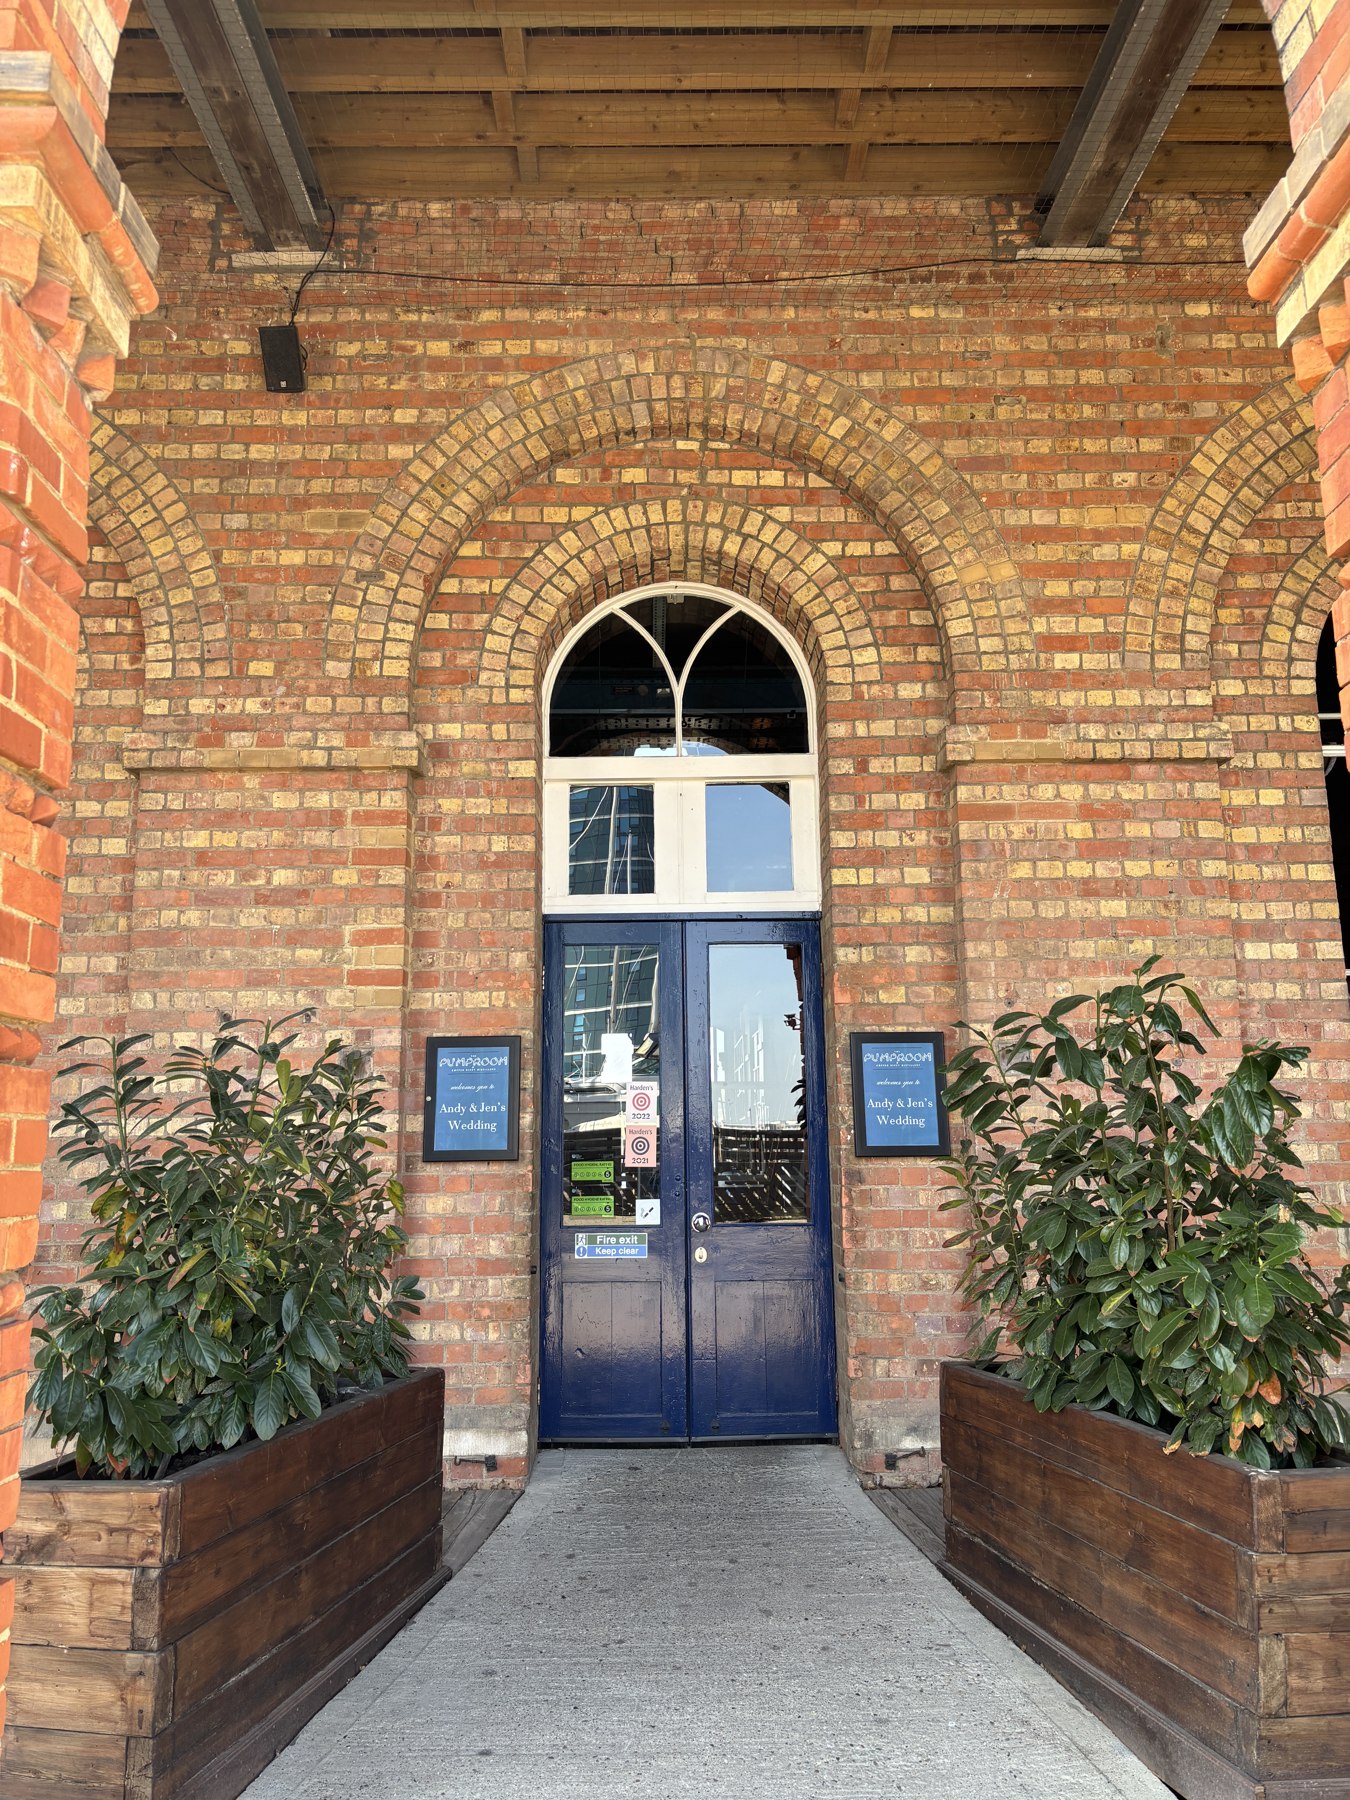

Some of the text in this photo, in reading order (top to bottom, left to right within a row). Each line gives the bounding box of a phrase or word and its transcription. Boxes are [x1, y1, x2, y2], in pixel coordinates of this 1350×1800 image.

[439, 1055, 508, 1067] PUMPROOM
[863, 1052, 932, 1062] PUMPROOM
[439, 1101, 506, 1116] Andy & Jen's
[867, 1097, 934, 1111] Andy & Jen's
[631, 1112, 651, 1120] 2022
[876, 1114, 926, 1129] Wedding
[448, 1119, 498, 1133] Wedding
[596, 1235, 638, 1244] Fire exit
[595, 1247, 639, 1256] Keep clear
